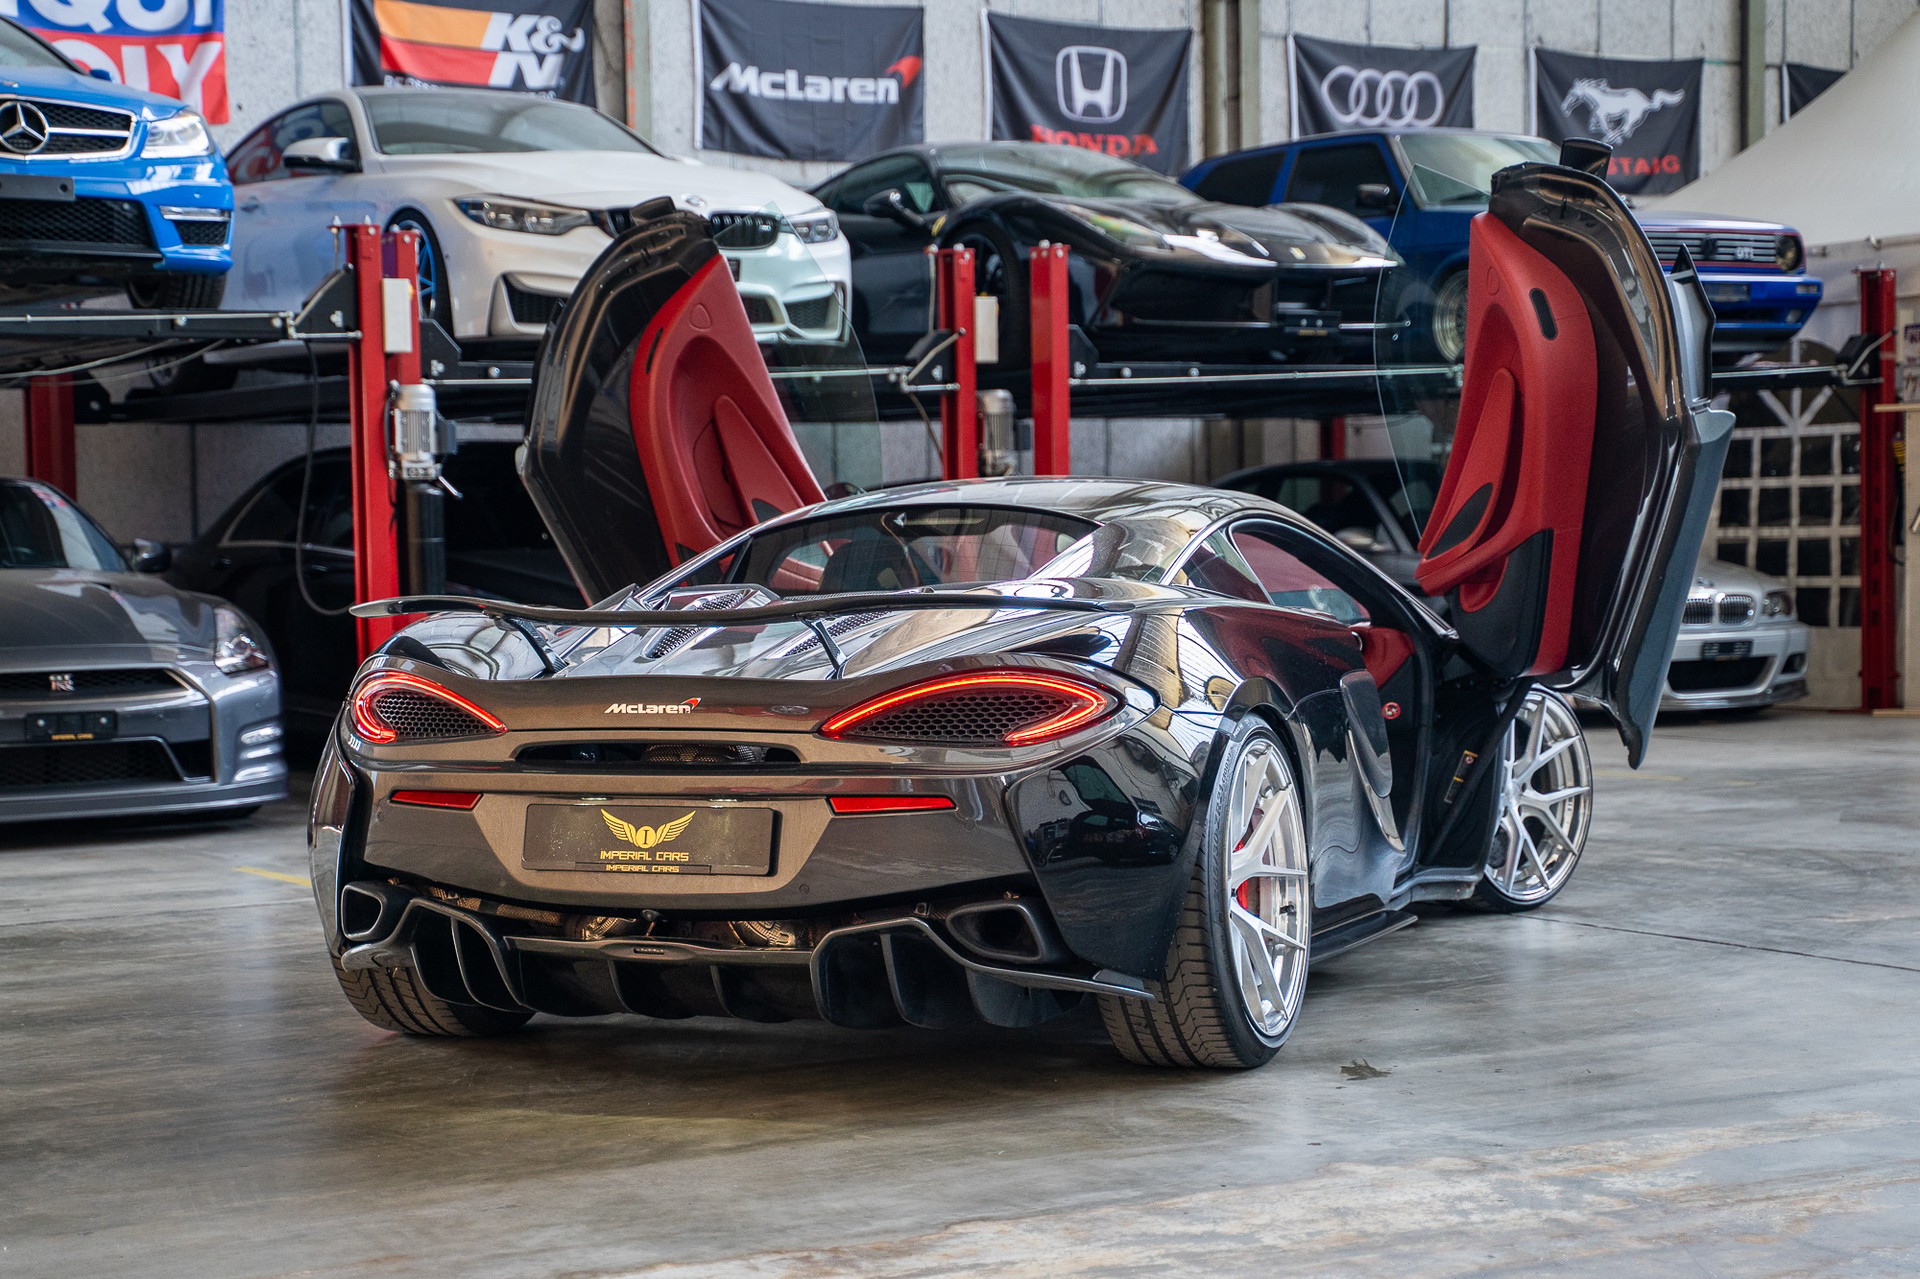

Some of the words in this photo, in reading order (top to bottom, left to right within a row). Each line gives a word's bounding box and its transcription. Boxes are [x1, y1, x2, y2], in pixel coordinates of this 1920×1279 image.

[487, 51, 564, 90] N
[709, 61, 900, 105] McLaren
[1030, 123, 1158, 158] HONDA
[604, 703, 691, 714] McLaren
[600, 850, 653, 861] IMPERIAL
[656, 851, 690, 862] CARS
[605, 864, 649, 872] IMPERIAL
[651, 865, 680, 873] CARS
